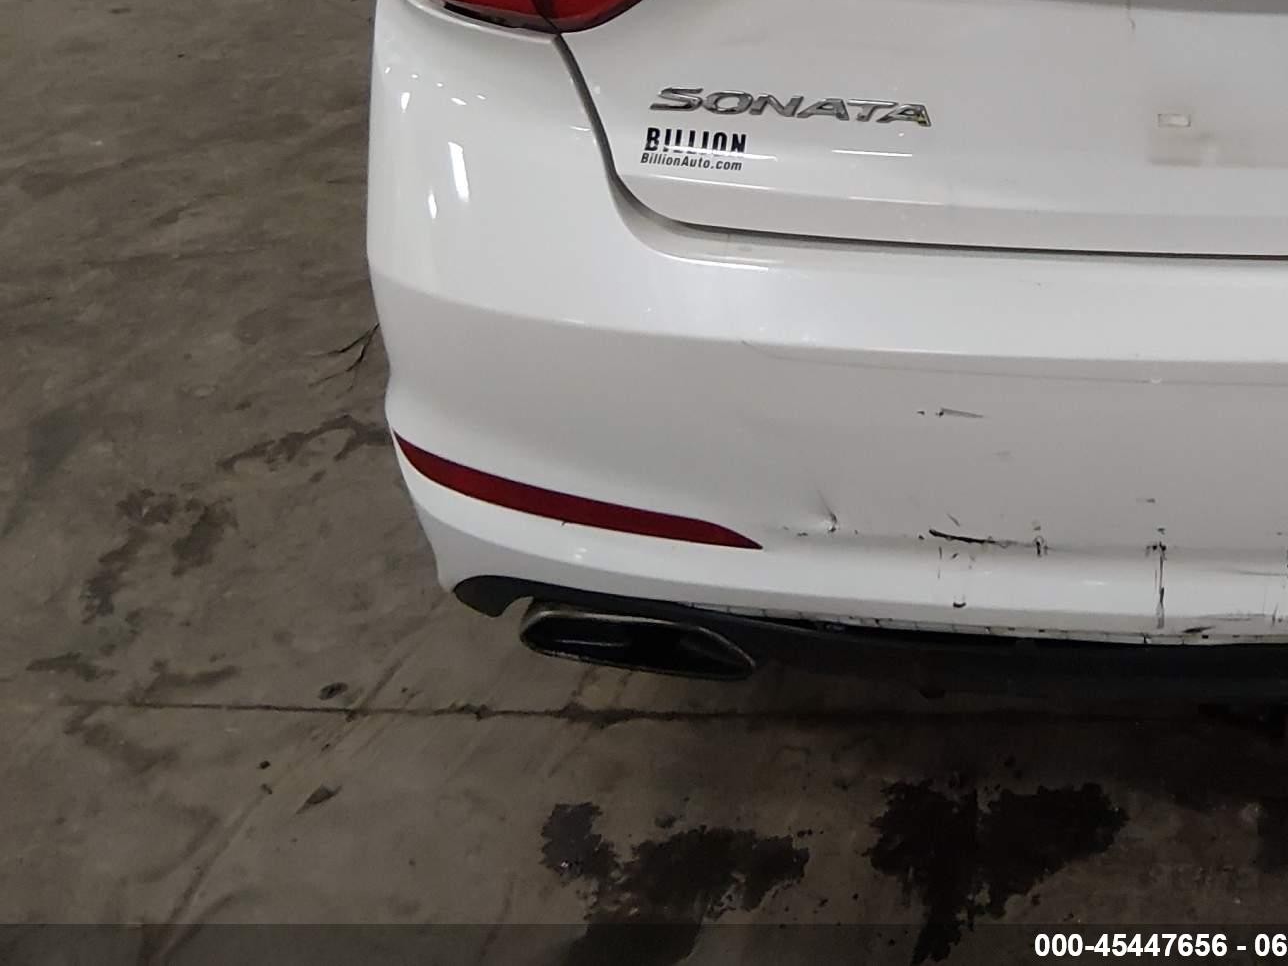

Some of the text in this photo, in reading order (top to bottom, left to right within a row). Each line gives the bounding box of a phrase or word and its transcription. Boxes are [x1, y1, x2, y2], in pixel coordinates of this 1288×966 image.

[649, 87, 932, 127] SONATA
[644, 127, 747, 157] BILLION
[640, 153, 743, 171] BillionAuto.com
